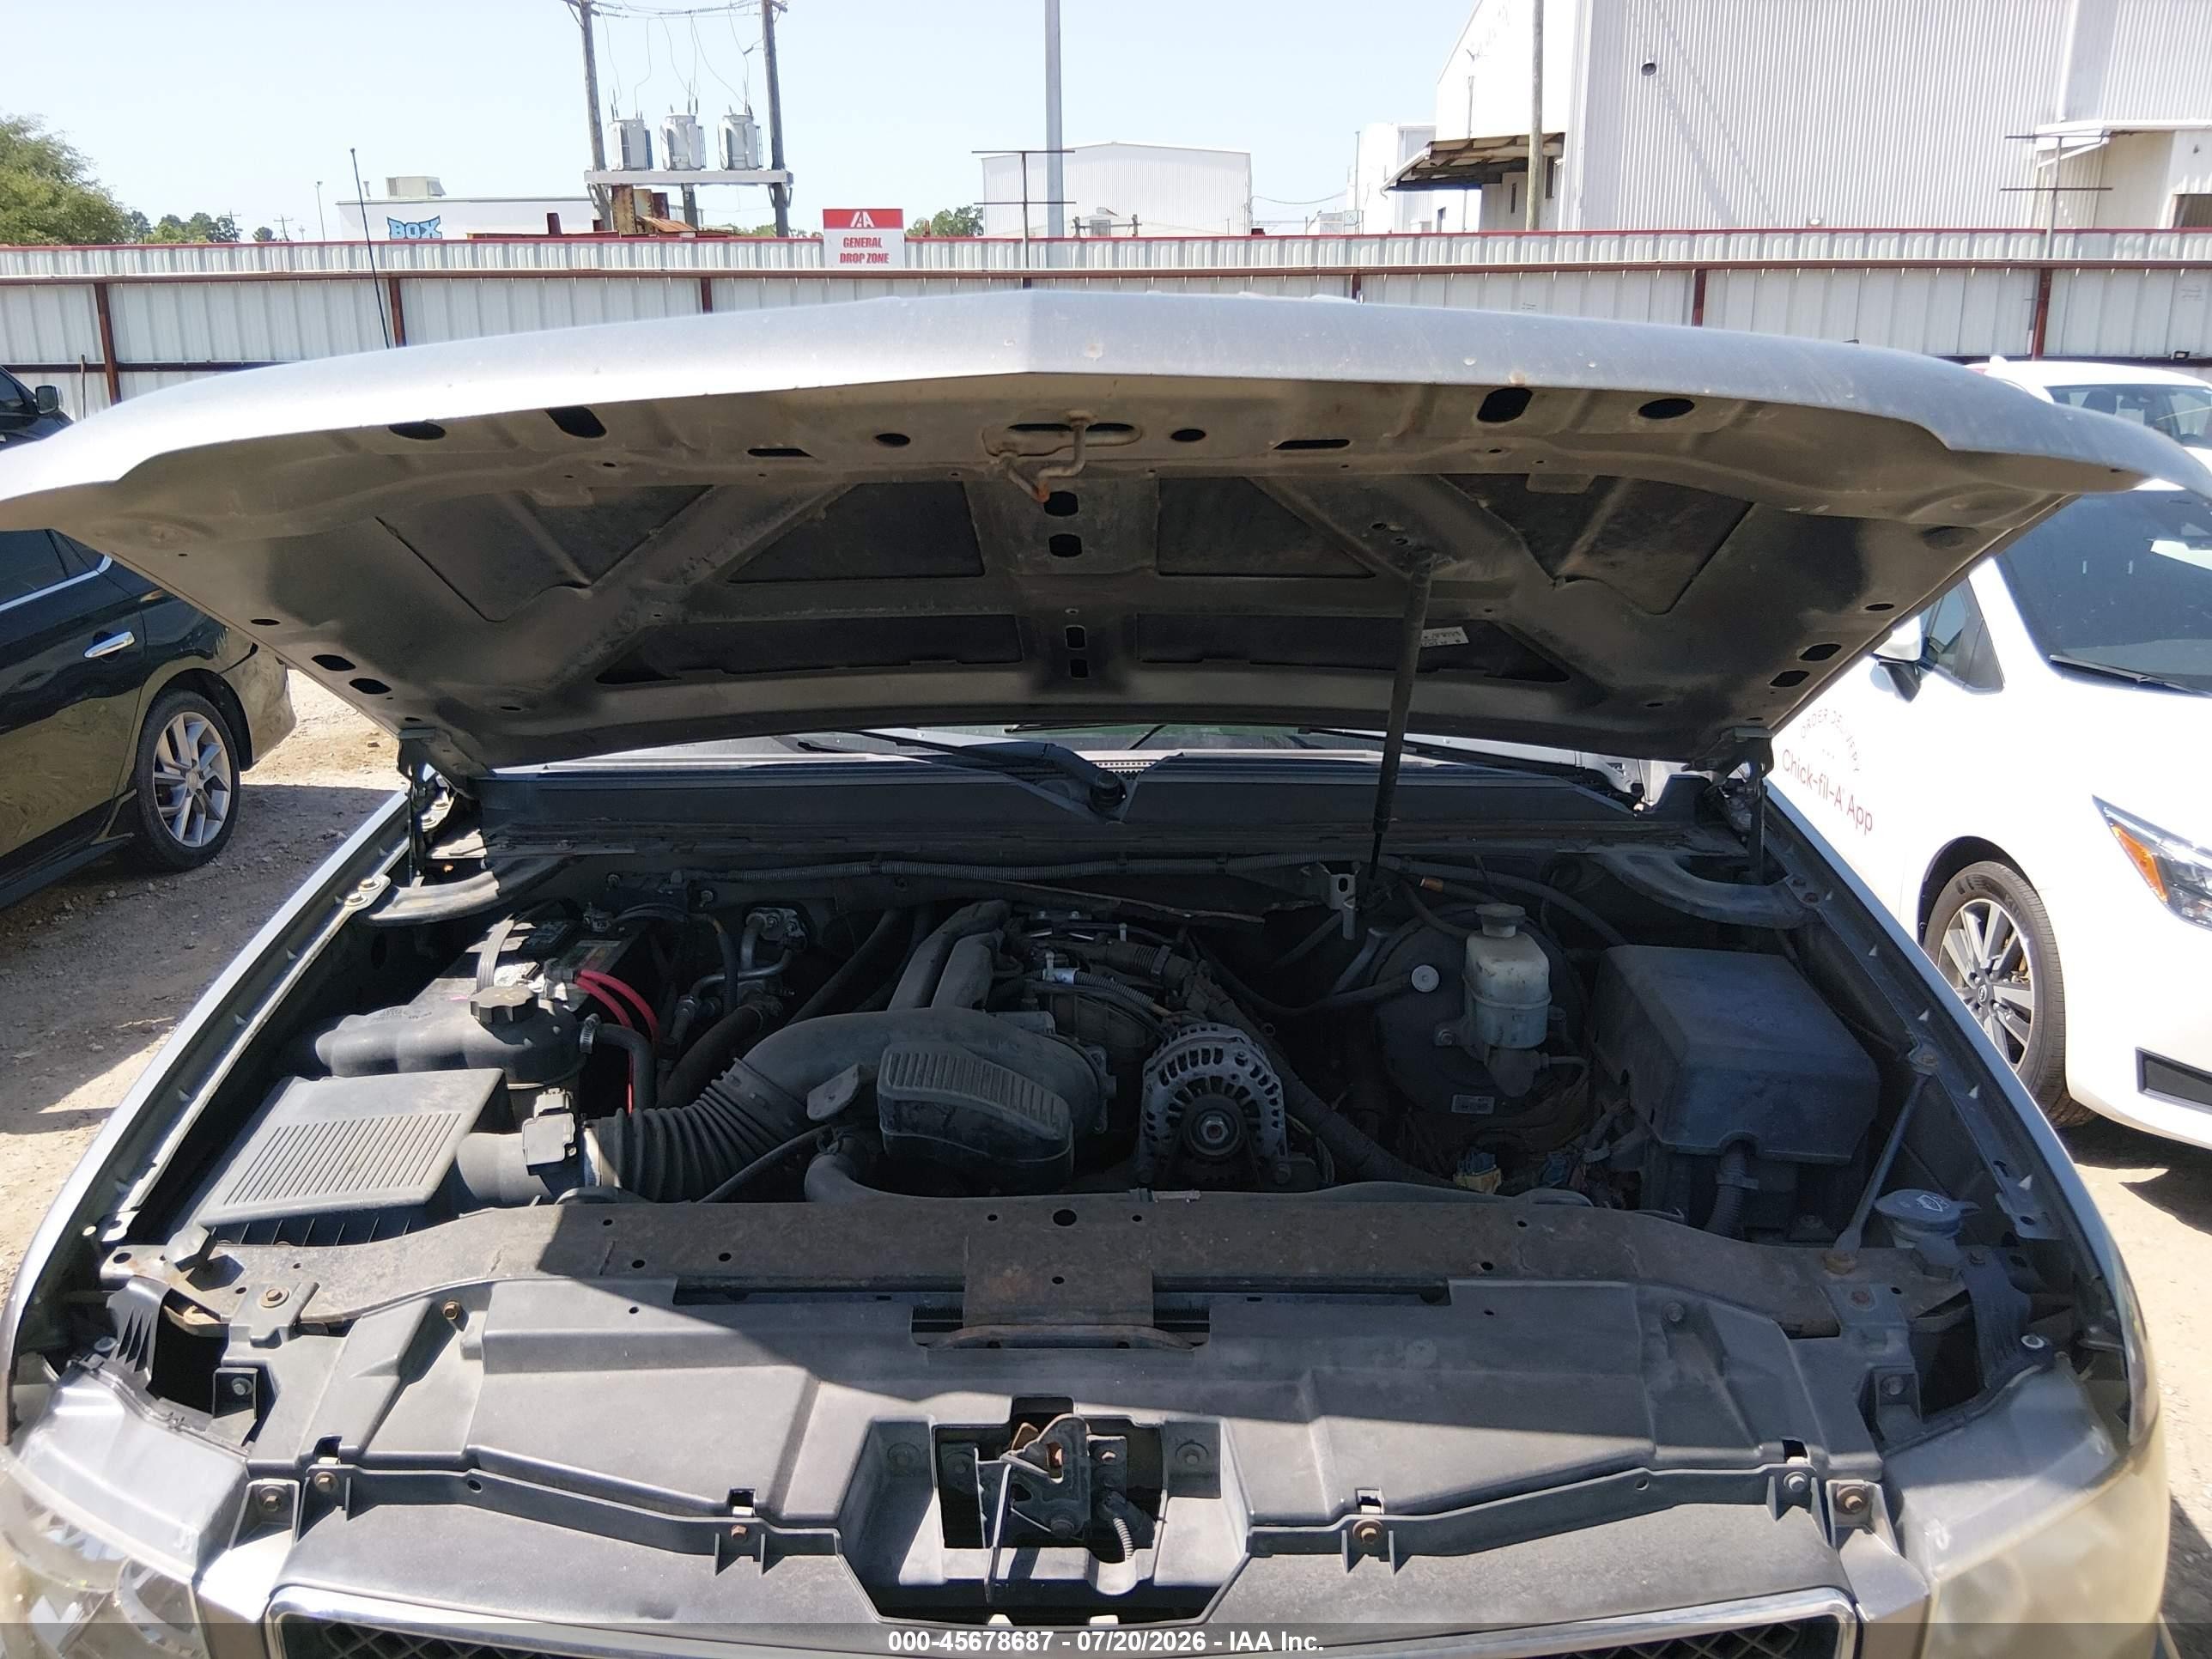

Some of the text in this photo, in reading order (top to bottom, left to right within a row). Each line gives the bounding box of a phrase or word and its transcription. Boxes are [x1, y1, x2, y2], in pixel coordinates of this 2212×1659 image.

[386, 215, 442, 240] BOX
[843, 237, 882, 248] GENERAL
[840, 253, 890, 264] DROP ZONE
[1831, 710, 1861, 772] DELERY
[1846, 794, 1873, 836] App
